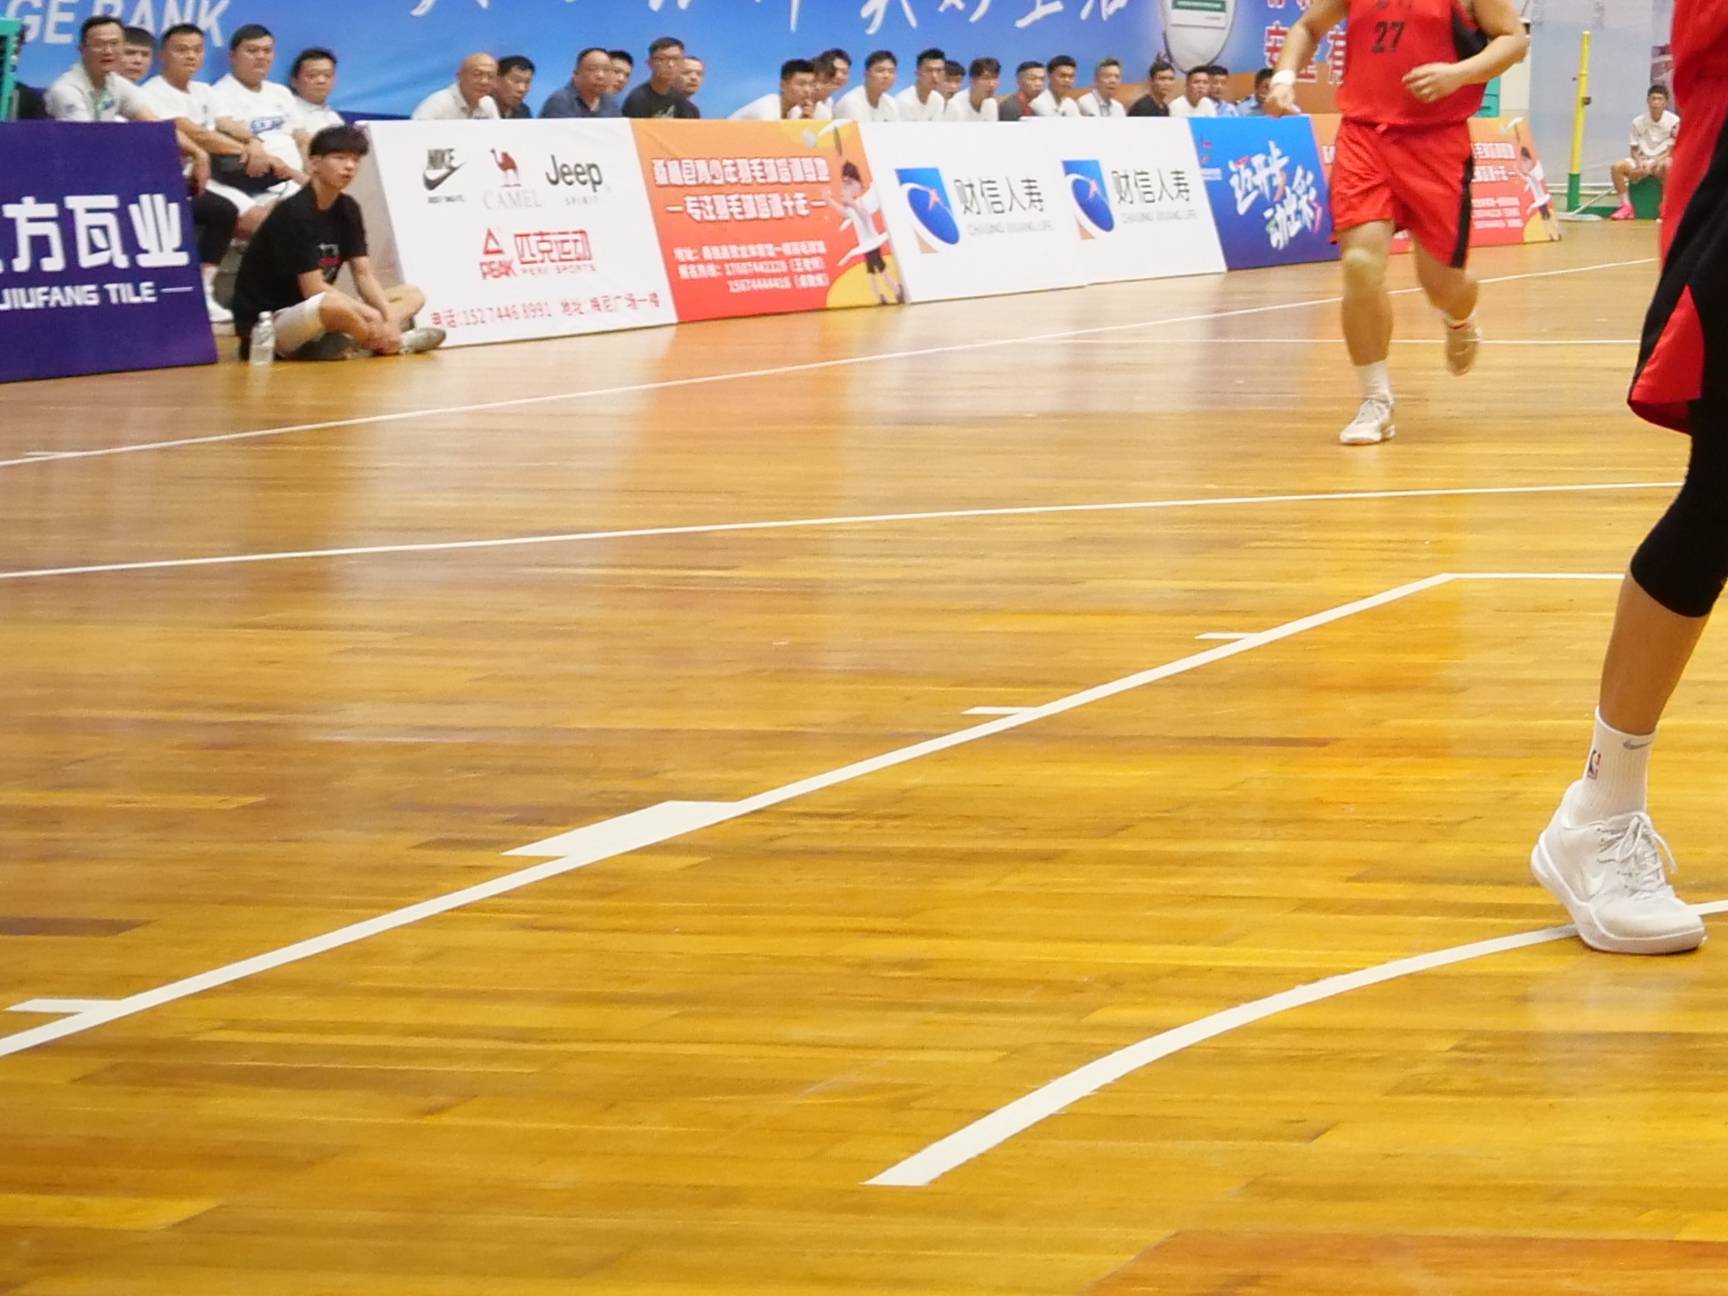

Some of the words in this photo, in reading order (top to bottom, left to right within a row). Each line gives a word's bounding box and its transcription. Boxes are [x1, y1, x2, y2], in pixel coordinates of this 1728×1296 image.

[1371, 20, 1406, 54] 27
[544, 153, 604, 193] Jeep
[1111, 167, 1191, 206] 财信人寿
[481, 189, 545, 210] CAMEL
[953, 176, 1045, 216] 财信人寿
[0, 193, 191, 273] 方瓦业
[479, 259, 516, 281] PEAK
[0, 284, 101, 311] JIUFANG
[103, 281, 158, 305] TILE
